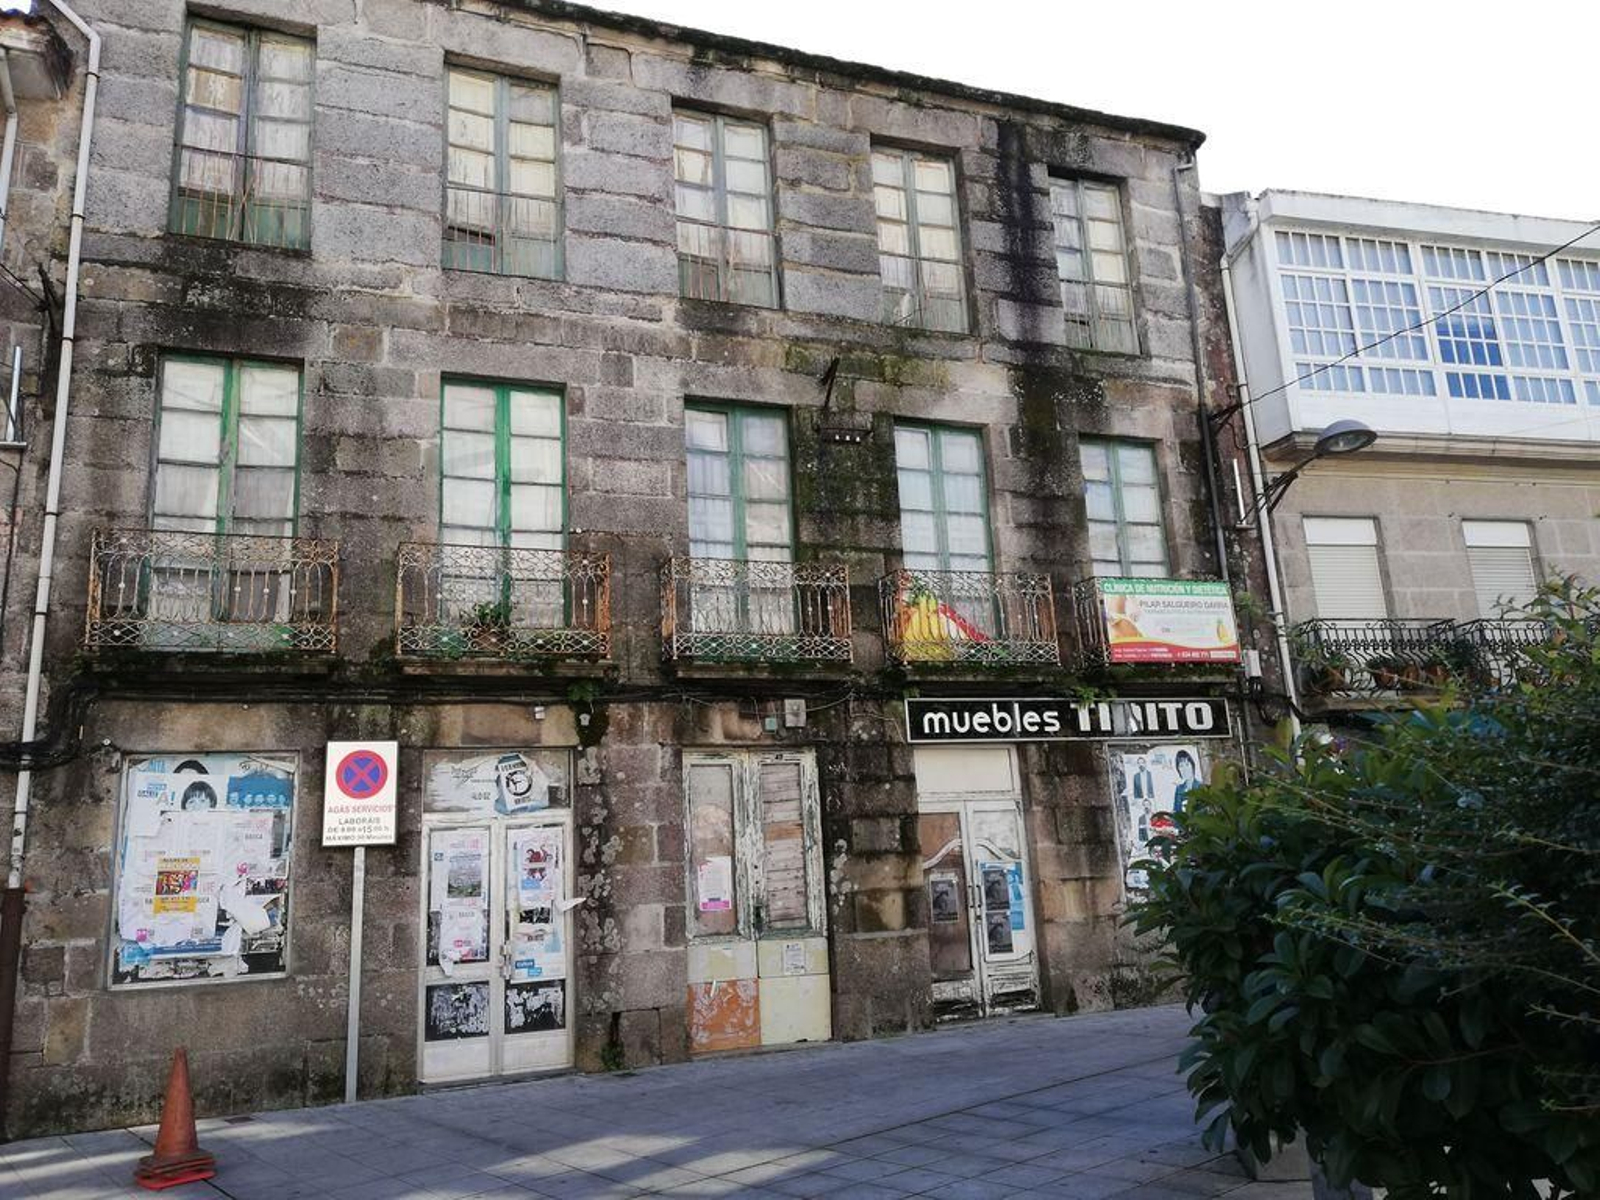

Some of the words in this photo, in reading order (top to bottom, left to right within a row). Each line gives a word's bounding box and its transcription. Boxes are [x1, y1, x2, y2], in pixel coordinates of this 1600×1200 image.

[1139, 600, 1161, 608] PILAR
[1162, 600, 1203, 609] SALGUEIRO
[922, 702, 1060, 734] muebles
[351, 804, 393, 813] SERVICIOS
